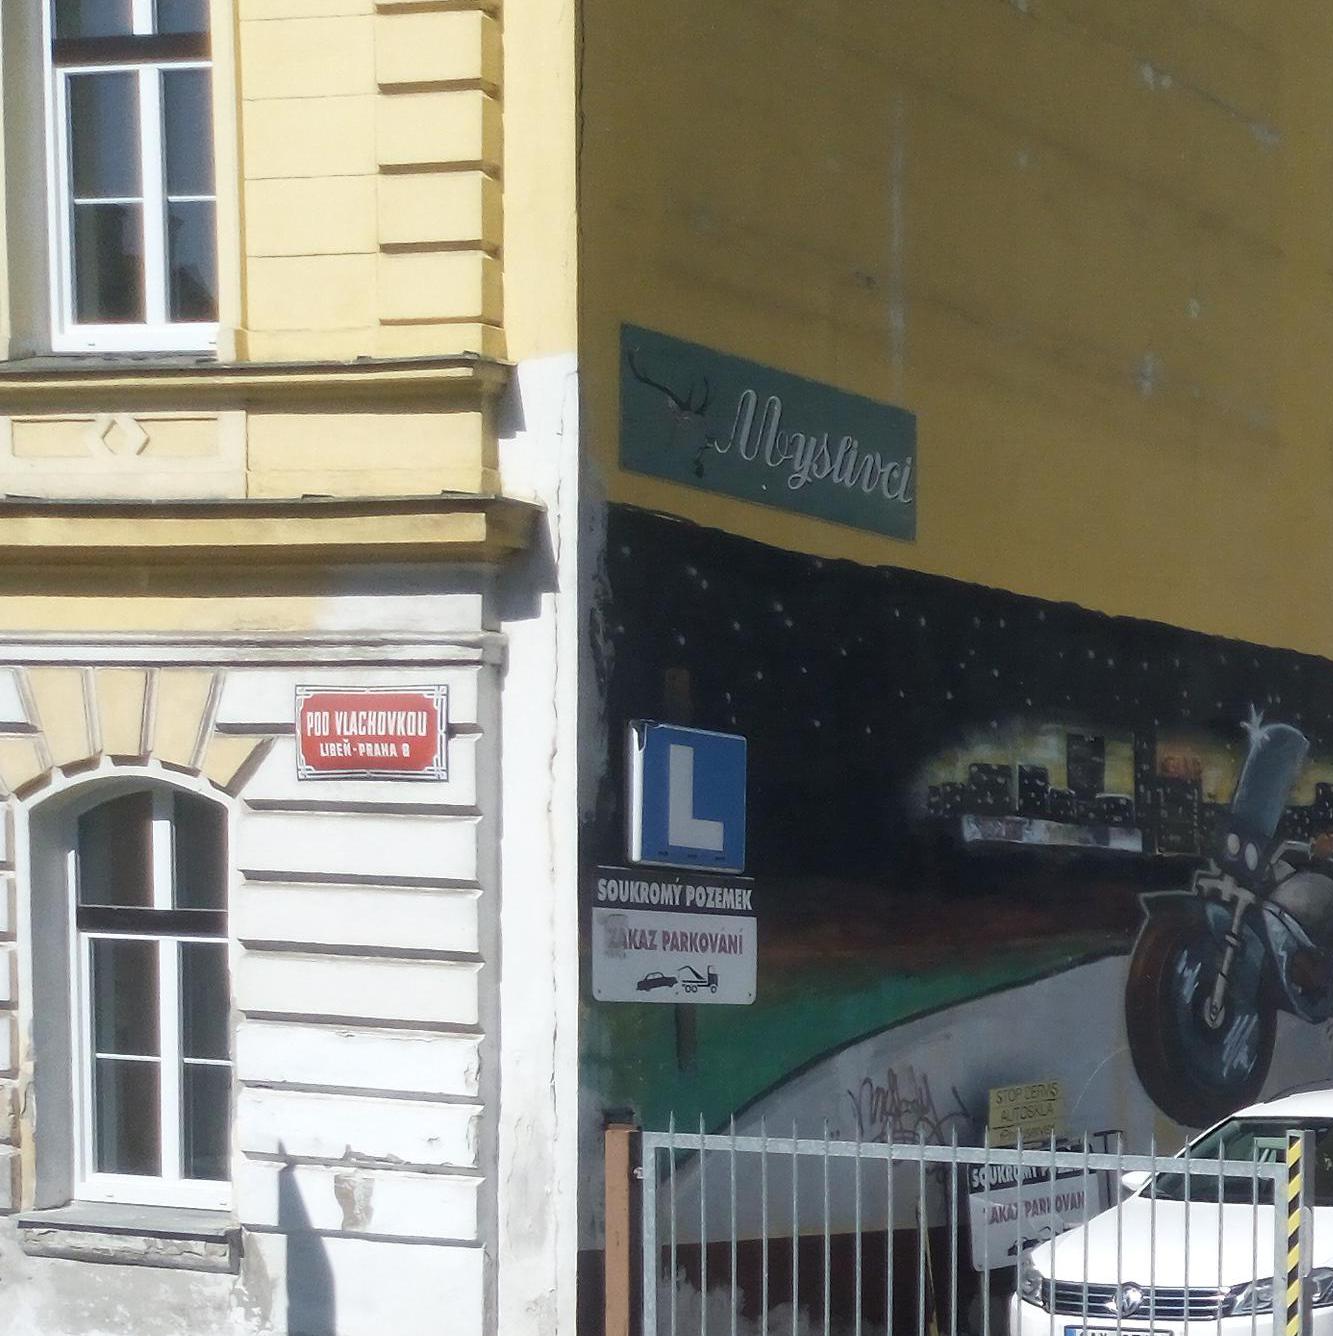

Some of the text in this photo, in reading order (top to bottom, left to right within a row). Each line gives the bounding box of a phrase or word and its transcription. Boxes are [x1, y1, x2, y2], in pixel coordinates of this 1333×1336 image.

[714, 389, 912, 504] Myslivci
[306, 711, 428, 737] POD VLACHOVKOU
[401, 743, 410, 757] 8
[668, 743, 724, 851] L
[598, 877, 753, 911] SOUKROMÝ POZEMEK
